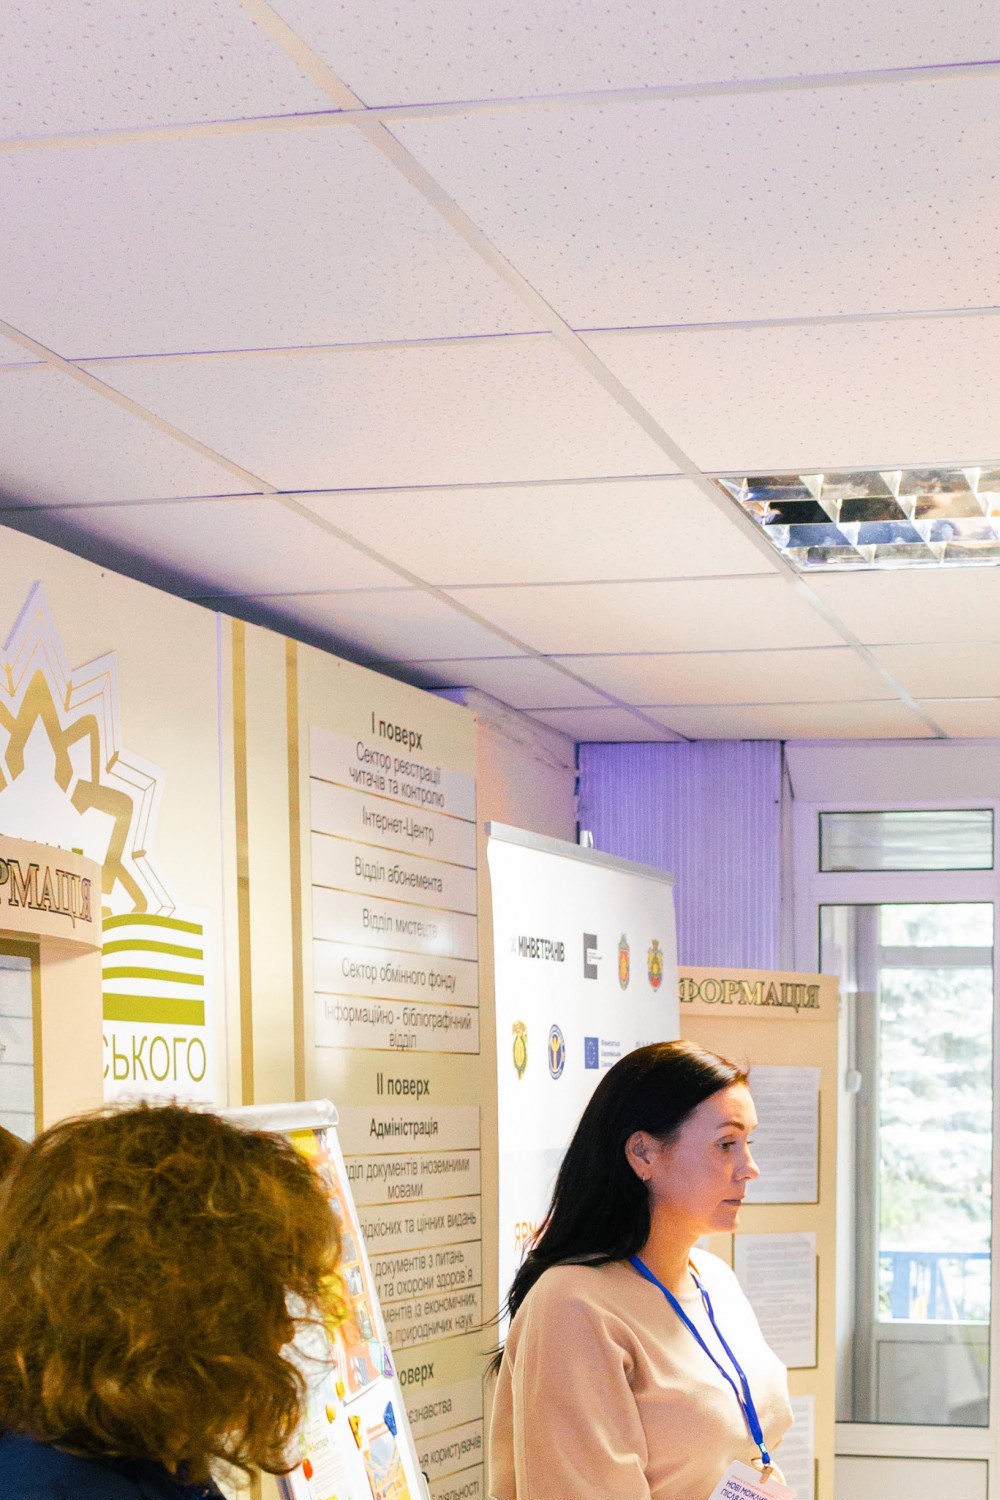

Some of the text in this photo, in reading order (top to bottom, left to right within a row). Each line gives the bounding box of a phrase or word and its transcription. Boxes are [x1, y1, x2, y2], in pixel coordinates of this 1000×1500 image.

[379, 720, 423, 751] поверх
[355, 741, 441, 789] Сектор реєстрації
[349, 766, 445, 812] читачів та контролю
[362, 805, 435, 845] Інтернет-Центр
[355, 856, 443, 893] Відділ абонемента
[362, 908, 393, 936] Відділ
[341, 957, 456, 994] Сектор обмінного фонду
[324, 1000, 393, 1026] Інформаційно
[403, 1007, 472, 1033] бібліографічний
[389, 1029, 417, 1050] відділ
[387, 1078, 430, 1100] поверх
[369, 1117, 439, 1140] Адміністрація
[366, 1157, 418, 1183] документів
[420, 1156, 470, 1177] іноземними
[388, 1182, 423, 1199] мовами
[404, 1219, 415, 1234] та
[417, 1213, 445, 1235] цінних
[447, 1212, 477, 1229] видань
[375, 1252, 426, 1279] документів
[428, 1254, 434, 1268] з
[435, 1250, 465, 1267] питань
[384, 1282, 394, 1297] та
[396, 1276, 434, 1297] охорони
[415, 1300, 422, 1317] із
[396, 1319, 453, 1344] природничих
[455, 1313, 474, 1334] наук
[397, 1363, 434, 1387] оверх
[407, 1398, 452, 1424] єзнавства
[431, 1435, 482, 1467] користувачів
